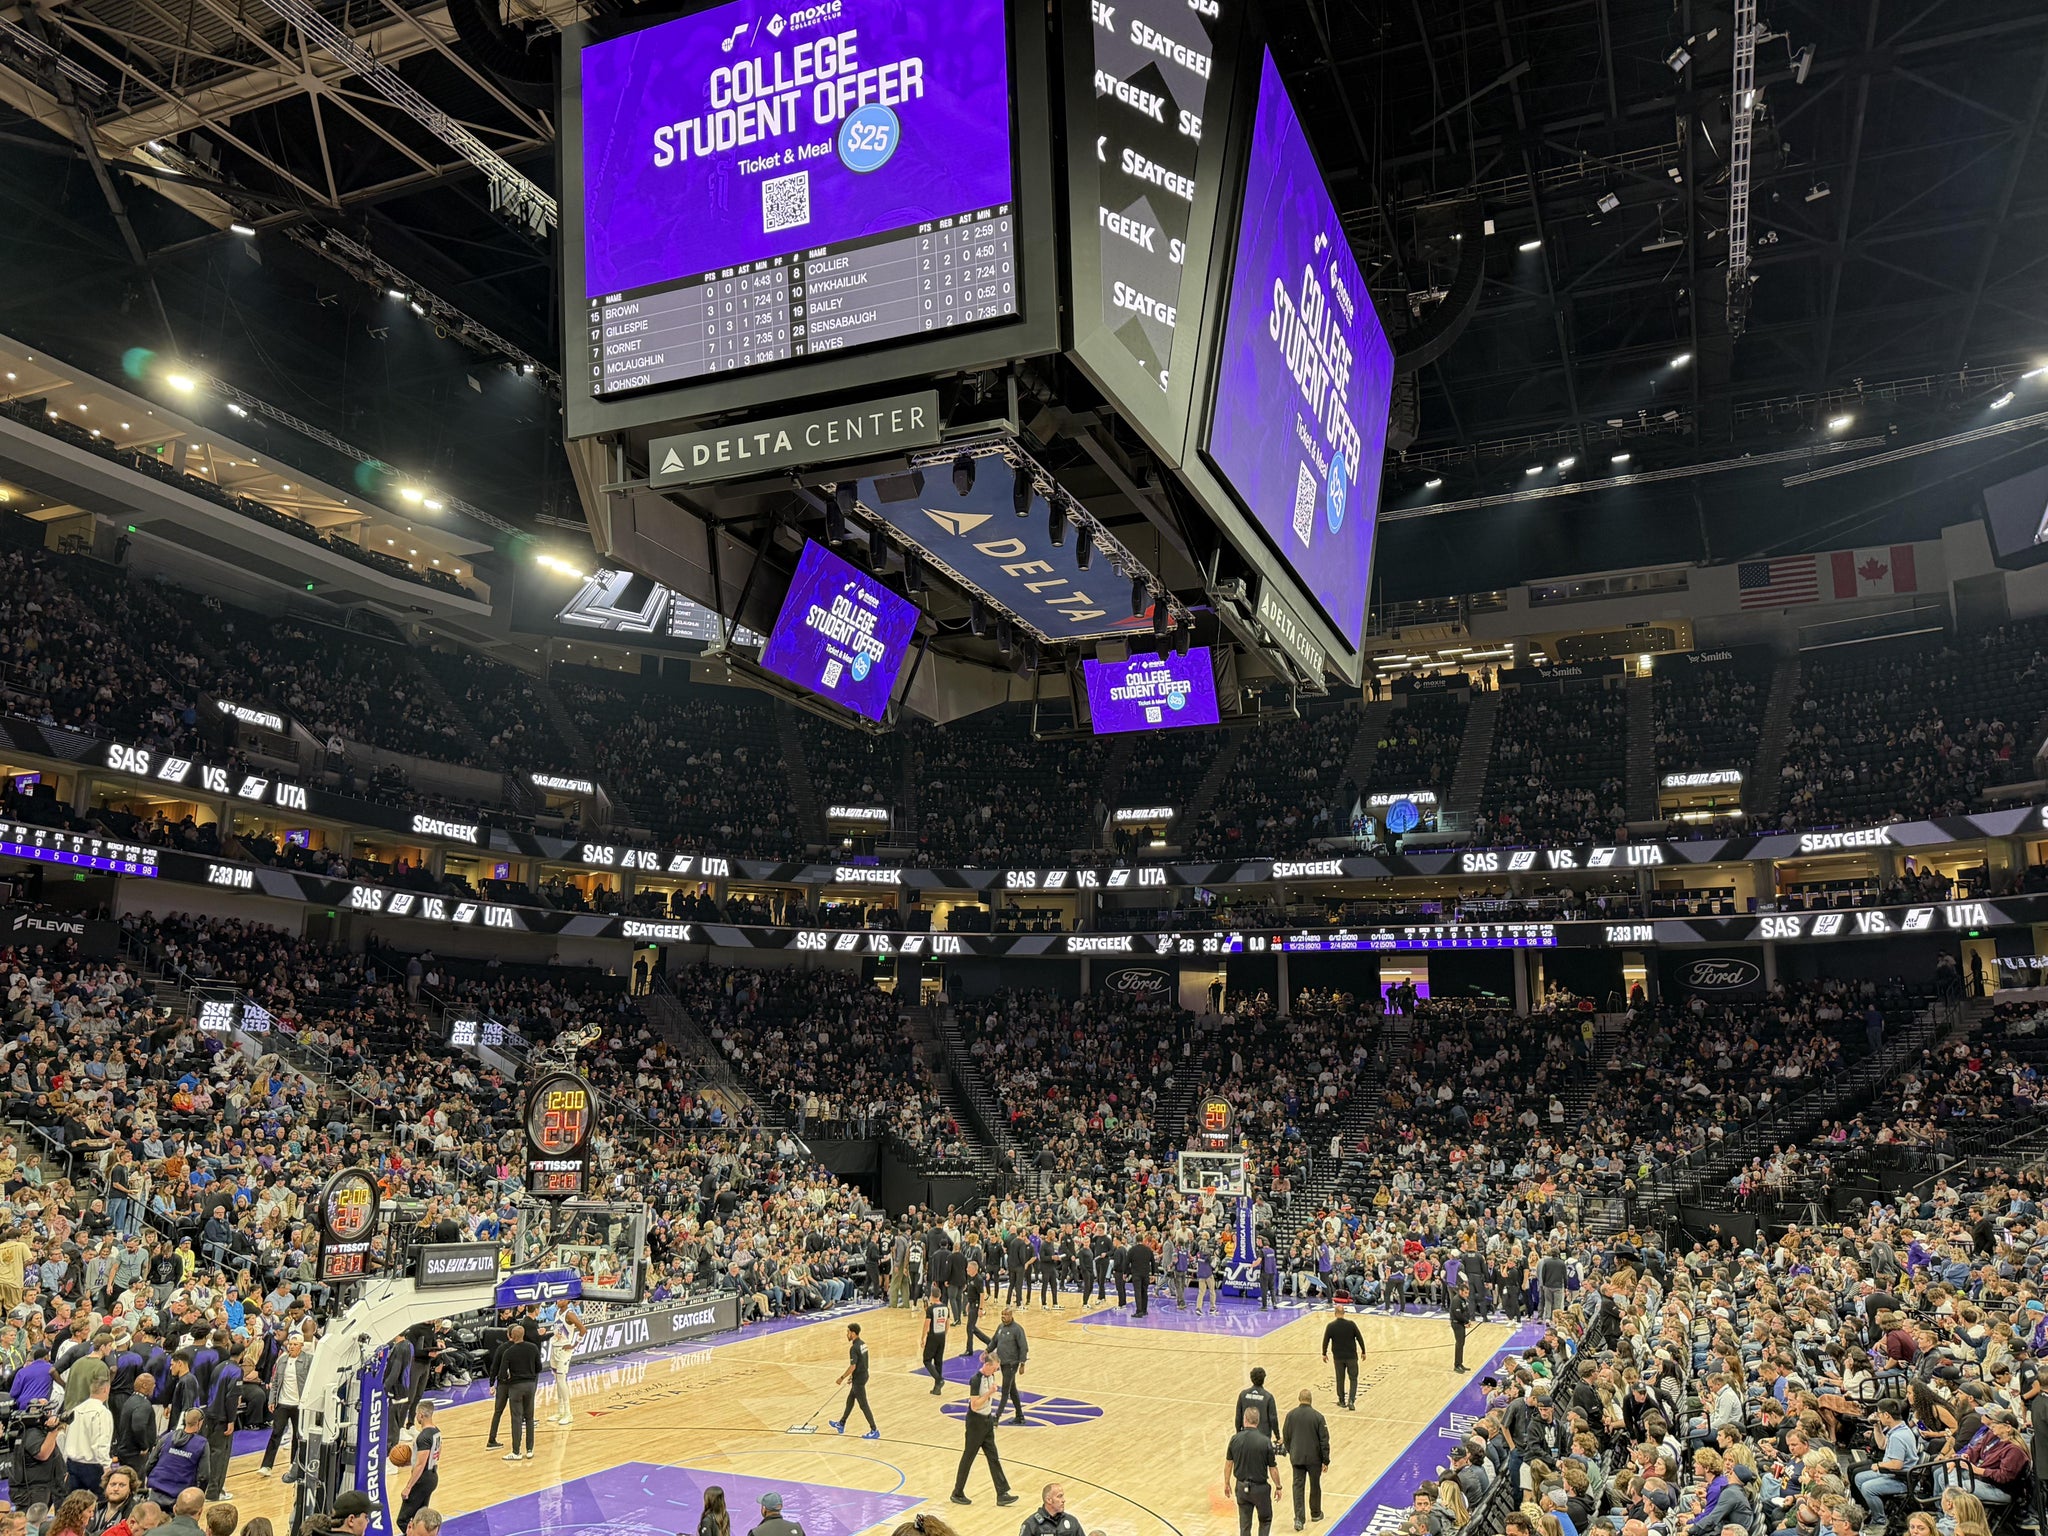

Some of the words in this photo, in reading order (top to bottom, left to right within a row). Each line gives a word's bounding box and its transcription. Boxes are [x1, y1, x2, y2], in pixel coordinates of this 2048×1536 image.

[790, 0, 842, 25] moxie
[790, 18, 820, 31] COLLEGE
[823, 12, 841, 22] CLUB
[709, 29, 858, 110] COLLEGE
[653, 89, 801, 168] STUDENT
[813, 57, 924, 125] OFFER
[847, 120, 890, 152] $25
[738, 151, 781, 176] Ticket
[783, 148, 795, 164] &
[798, 138, 833, 159] Meal
[793, 267, 800, 279] 8
[808, 257, 849, 275] COLLIER
[975, 224, 994, 239] 2:59
[792, 286, 803, 298] 10
[809, 272, 868, 295] MYKHAILIUK
[976, 243, 995, 258] 4:50
[590, 311, 600, 323] 15
[605, 304, 639, 320] BROWN
[754, 274, 771, 287] 4:43
[793, 306, 804, 318] 19
[810, 297, 843, 315] BAILEY
[976, 264, 995, 279] 7:24
[591, 329, 600, 340] 17
[606, 320, 648, 338] GILLESPIE
[754, 294, 771, 307] 7:24
[792, 325, 805, 337] 28
[811, 310, 877, 333] SENSABAUGH
[977, 286, 996, 300] 0:52
[593, 348, 599, 358] 7
[606, 340, 642, 356] KORNET
[755, 313, 772, 325] 7:35
[811, 337, 843, 353] HAYES
[978, 305, 997, 318] 7:35
[1301, 263, 1353, 402] COLLEGE
[593, 365, 600, 377] 0
[607, 354, 664, 374] MCLAUGHLIN
[756, 332, 773, 345] 7:35
[607, 374, 650, 392] JOHNSON
[1269, 277, 1330, 424] STUDENT
[1326, 388, 1361, 487] OFFER
[692, 429, 794, 467] DELTA
[805, 406, 926, 448] CENTER
[1296, 411, 1312, 453] Ticket
[1315, 447, 1329, 480] Meal
[1330, 465, 1344, 518] $25
[972, 537, 1108, 623] DELTA
[831, 594, 878, 636] COLLEGE
[805, 604, 856, 646] STUDENT
[852, 630, 885, 663] OFFER
[1269, 600, 1296, 642] DELTA
[1296, 630, 1323, 676] CENTER
[1700, 651, 1733, 663] Smith's
[1125, 669, 1172, 686] COLLEGE
[1552, 667, 1583, 677] Smith's
[1110, 684, 1156, 701] STUDENT
[1158, 680, 1192, 696] OFFER
[107, 743, 149, 775] SAS
[203, 765, 230, 793] VS.
[276, 783, 308, 811] UTA
[532, 774, 549, 786] SAS
[577, 781, 592, 793] UTA
[1667, 775, 1687, 786] SAS
[1722, 771, 1741, 782] UTA
[1371, 795, 1388, 805] SAS
[1419, 792, 1436, 802] UTA
[830, 807, 846, 817] SAS
[873, 809, 888, 819] UTA
[412, 814, 478, 844] SEATGEEK
[1800, 826, 1892, 853] SEATGEEK
[582, 843, 614, 866] SAS
[637, 850, 661, 871] VS.
[701, 855, 730, 879] UTA
[1273, 859, 1343, 878] SEATGEEK
[1463, 852, 1498, 872] SAS
[1547, 849, 1578, 869] VS.
[1627, 845, 1663, 865] UTA
[207, 863, 231, 885] 7:33
[234, 868, 253, 889] PM
[835, 866, 901, 885] SEATGEEK
[1006, 871, 1036, 889] SAS
[1076, 870, 1100, 888] VS.
[1138, 867, 1167, 886] UTA
[352, 885, 382, 911] SAS
[422, 897, 446, 921] VS.
[484, 906, 514, 928] UTA
[27, 917, 85, 935] FILEVINE
[622, 920, 691, 942] SEATGEEK
[1605, 925, 1633, 942] 7:33
[1634, 924, 1653, 941] PM
[1761, 916, 1800, 938] SAS
[1855, 912, 1890, 933] VS.
[1946, 903, 1988, 928] UTA
[797, 932, 827, 950] SAS
[868, 934, 892, 953] VS.
[932, 936, 961, 954] UTA
[1067, 935, 1133, 952] SEATGEEK
[1179, 938, 1195, 952] 26
[1203, 938, 1218, 952] 33
[1249, 936, 1265, 951] 0.0
[1117, 971, 1163, 990] Ford
[1689, 963, 1744, 985] Ford
[202, 1001, 234, 1018] SEAT
[199, 1016, 233, 1032] GEEK
[454, 1020, 477, 1033] SEAT
[451, 1032, 476, 1046] GEEK
[548, 1090, 585, 1110] 12:00
[1206, 1103, 1227, 1114] 12:00
[544, 1110, 580, 1145] 24
[1205, 1113, 1226, 1130] 24
[545, 1160, 583, 1171] TISSOT
[338, 1242, 370, 1253] TISSOT
[427, 1259, 446, 1274] SAS
[478, 1256, 494, 1271] UTA
[624, 1318, 650, 1345] UTA
[672, 1307, 716, 1332] SEATGEEK
[606, 1390, 687, 1411] DELTA
[369, 1388, 383, 1443] FIRST
